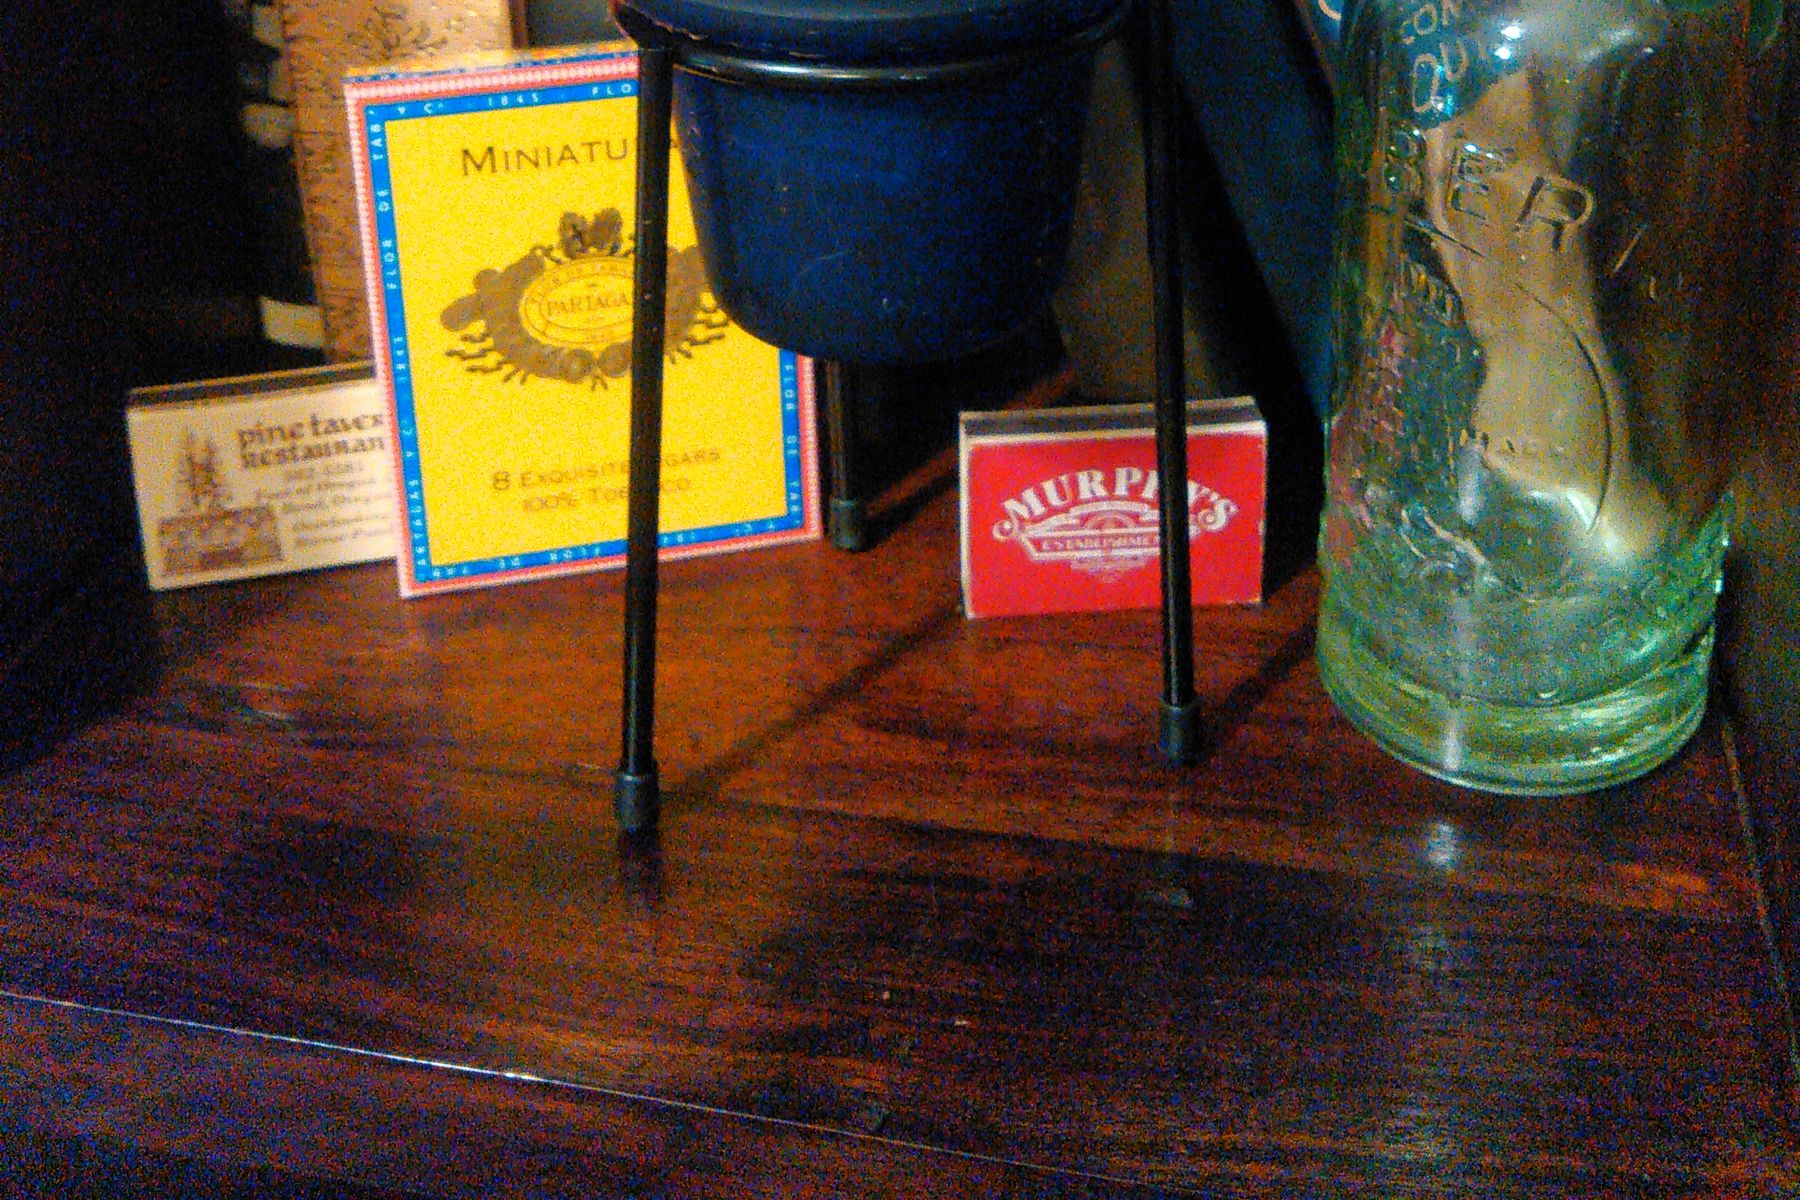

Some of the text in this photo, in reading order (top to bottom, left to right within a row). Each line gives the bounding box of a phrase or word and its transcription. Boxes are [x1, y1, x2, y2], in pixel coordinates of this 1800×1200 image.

[461, 137, 677, 176] MINIATU
[237, 421, 305, 452] pine
[493, 471, 510, 490] 8
